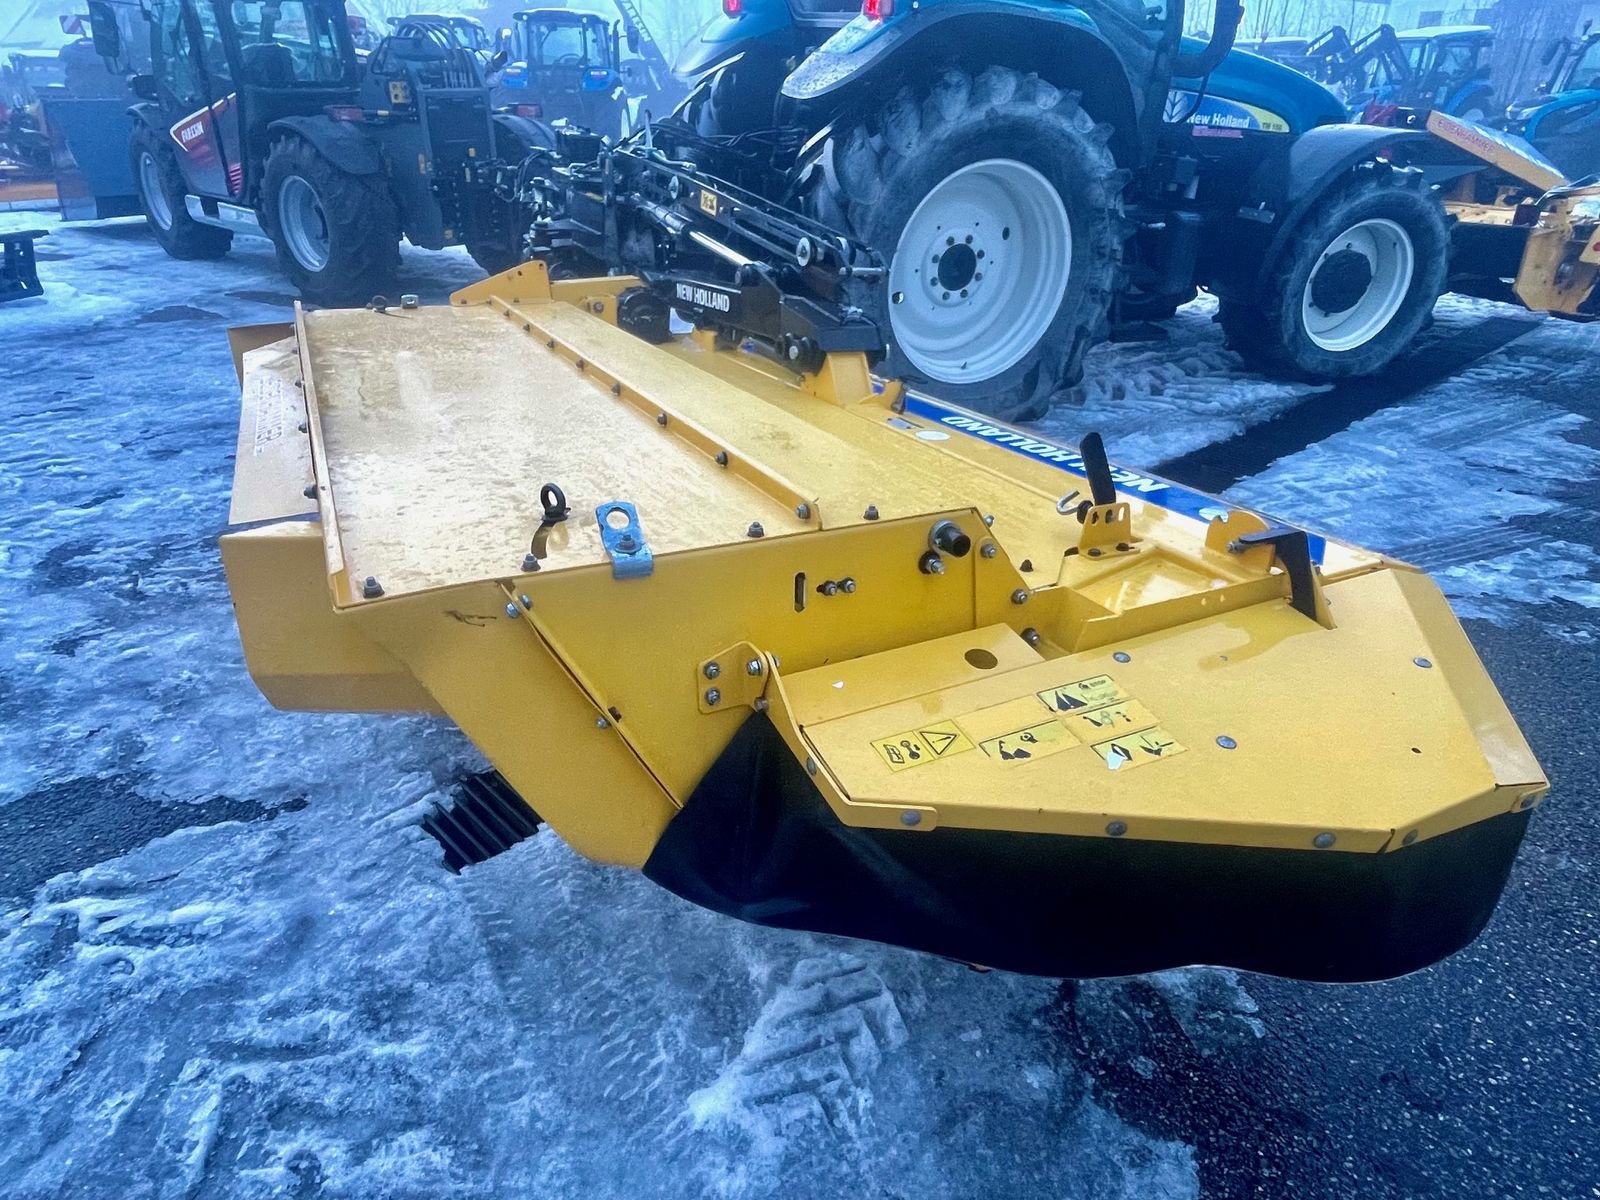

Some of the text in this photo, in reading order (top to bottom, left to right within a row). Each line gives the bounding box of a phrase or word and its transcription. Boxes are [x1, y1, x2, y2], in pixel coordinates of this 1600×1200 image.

[1212, 113, 1250, 128] Holland
[676, 283, 730, 313] NEW HOLLAND
[941, 416, 1071, 462] HOLLAND
